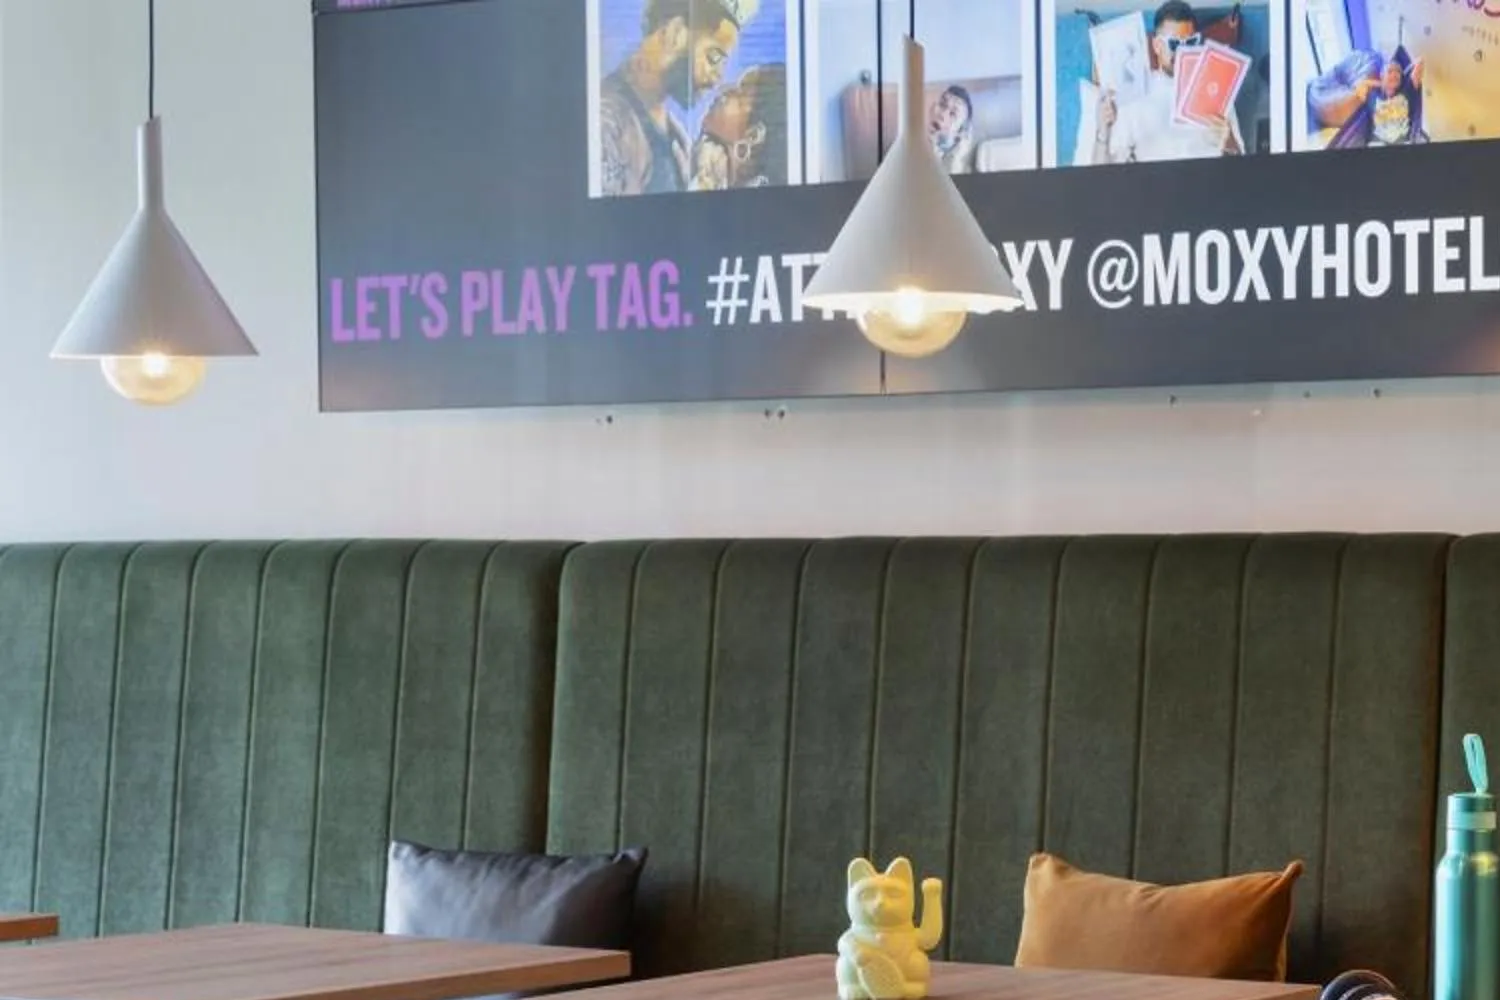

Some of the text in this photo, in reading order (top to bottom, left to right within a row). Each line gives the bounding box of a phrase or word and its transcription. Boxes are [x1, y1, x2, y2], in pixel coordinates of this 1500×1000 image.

[331, 272, 448, 343] LET'S
[461, 265, 576, 336] PLAY
[586, 259, 695, 331] TAG.
[705, 239, 1074, 325] #ATXY
